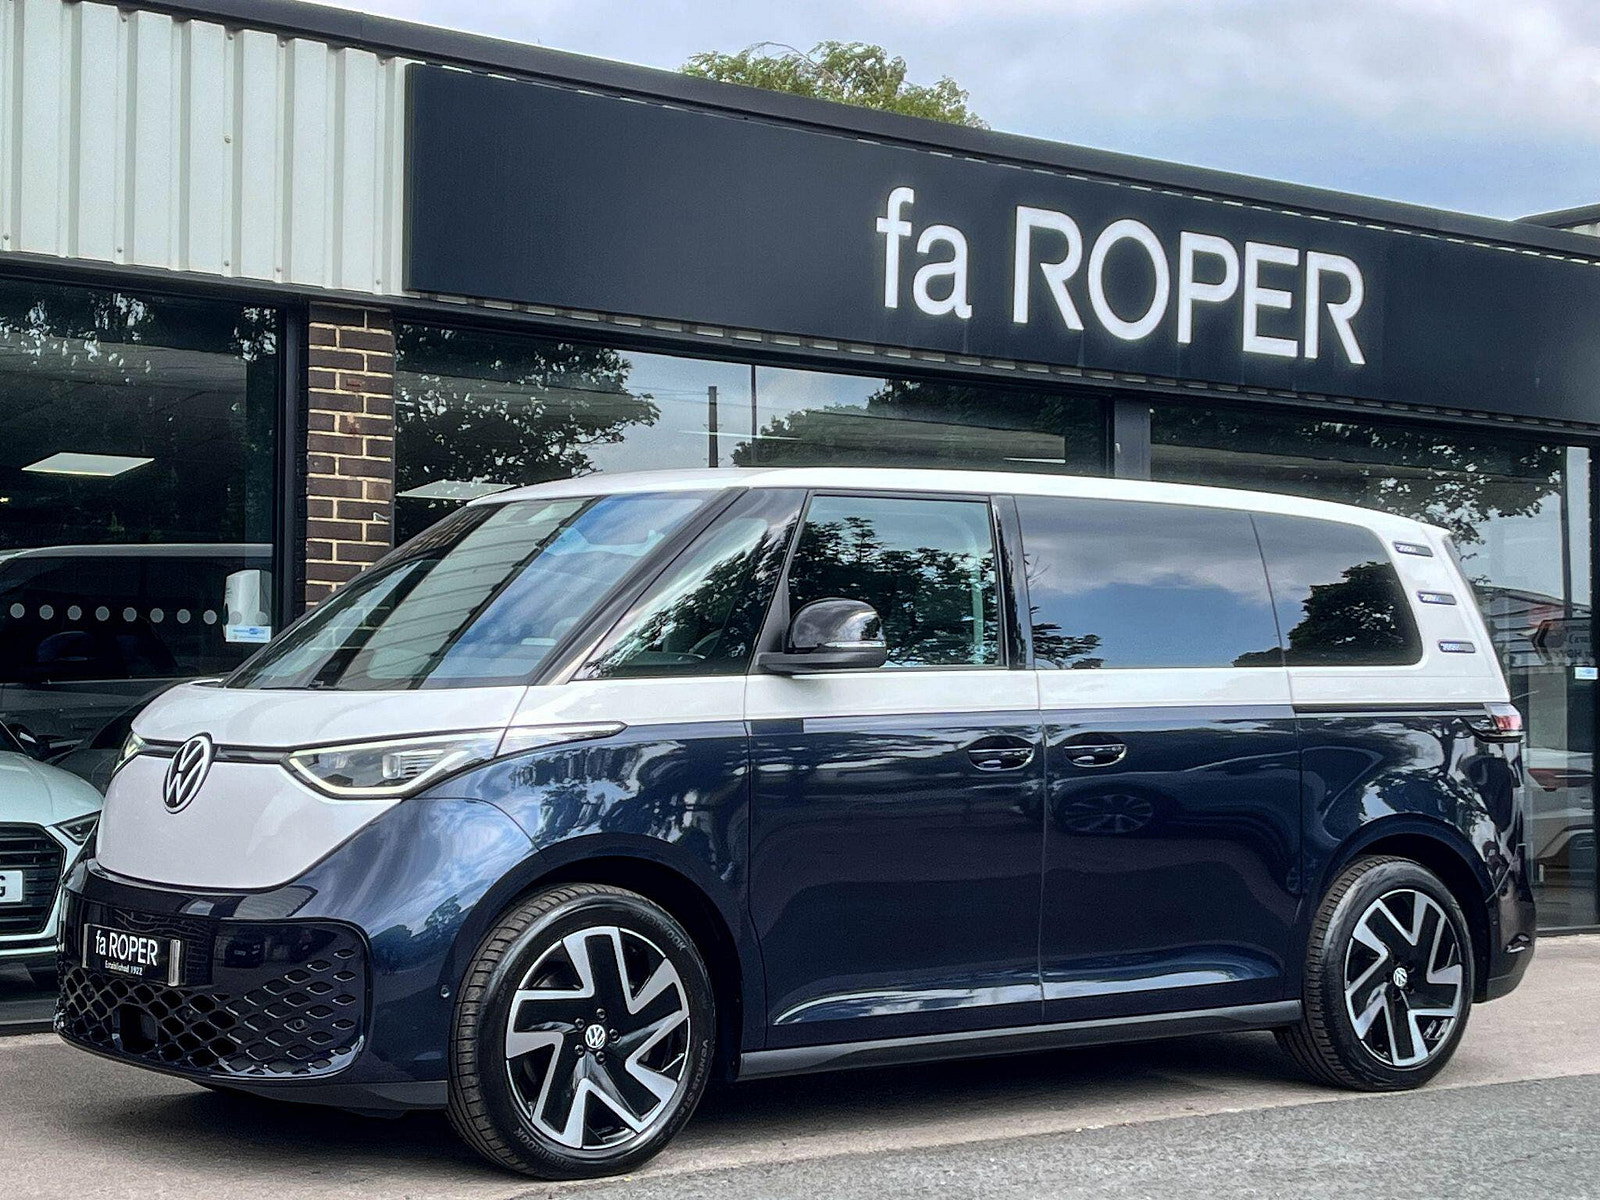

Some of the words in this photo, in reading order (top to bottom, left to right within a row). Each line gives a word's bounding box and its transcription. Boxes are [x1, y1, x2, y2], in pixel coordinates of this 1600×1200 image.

[876, 186, 973, 319] fa
[1012, 205, 1366, 366] ROPER
[95, 929, 107, 956] fa
[108, 932, 158, 967] ROPER
